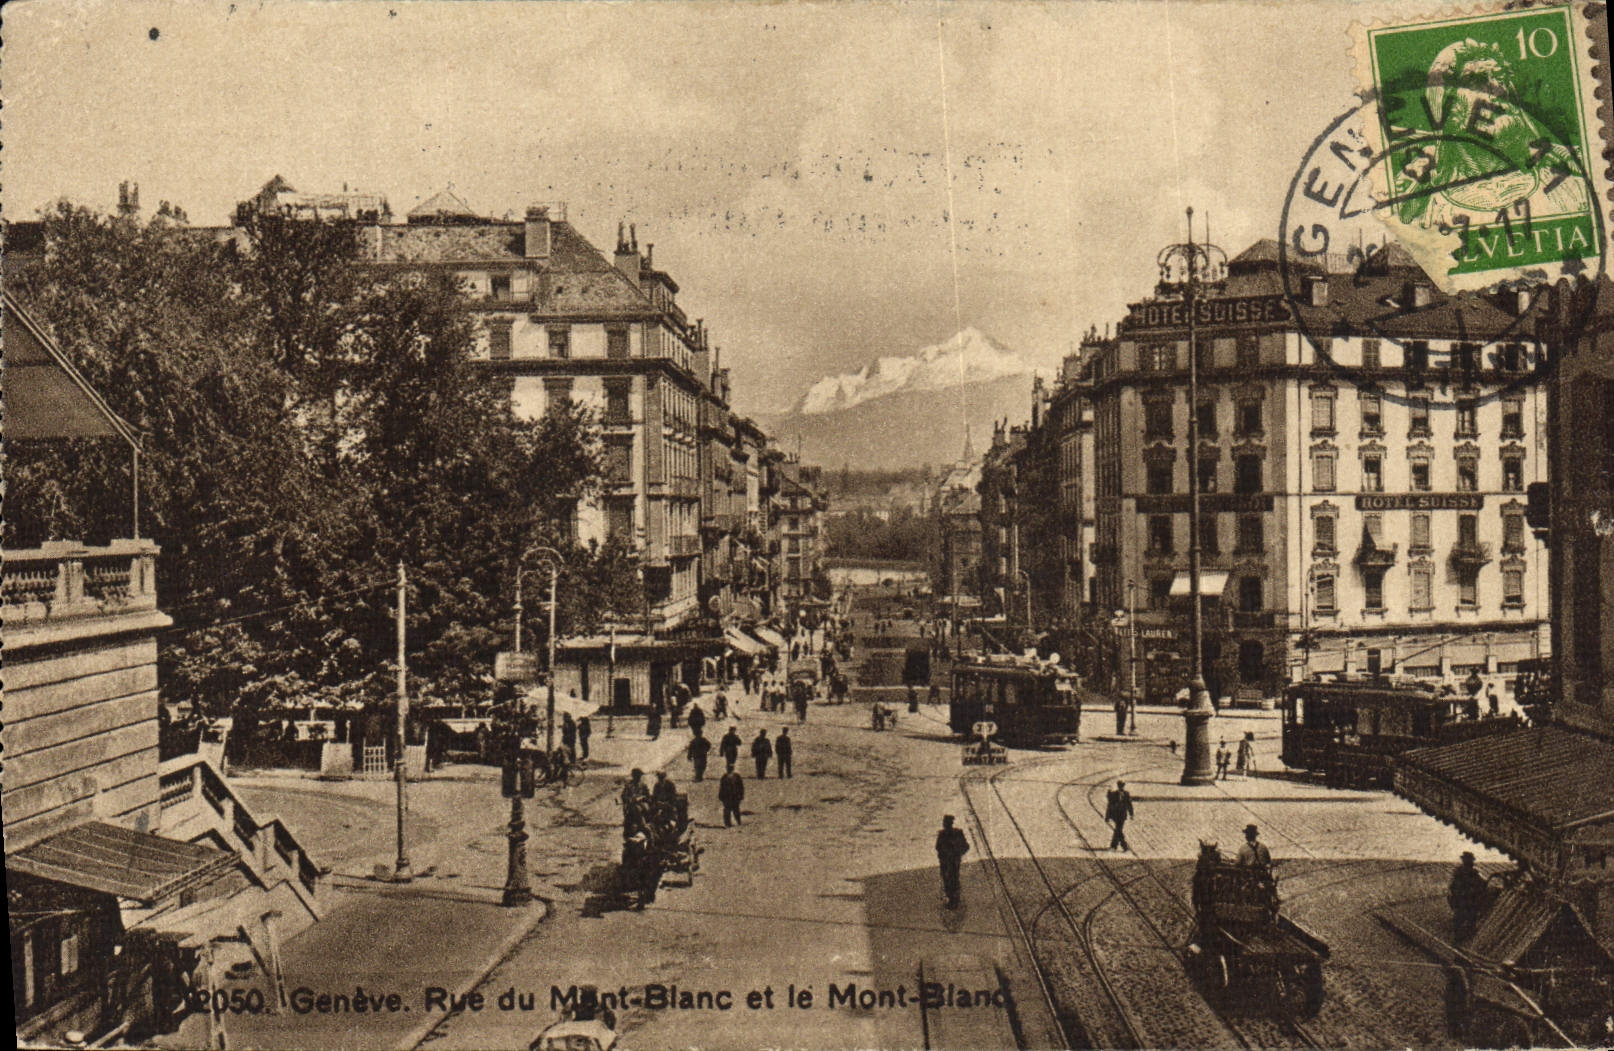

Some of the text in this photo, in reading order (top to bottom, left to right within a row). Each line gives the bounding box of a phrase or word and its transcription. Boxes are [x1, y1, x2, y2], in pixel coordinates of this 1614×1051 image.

[1515, 26, 1558, 60] 10
[1200, 299, 1275, 322] SUISSE
[1361, 495, 1479, 508] HOTEL SUISSE
